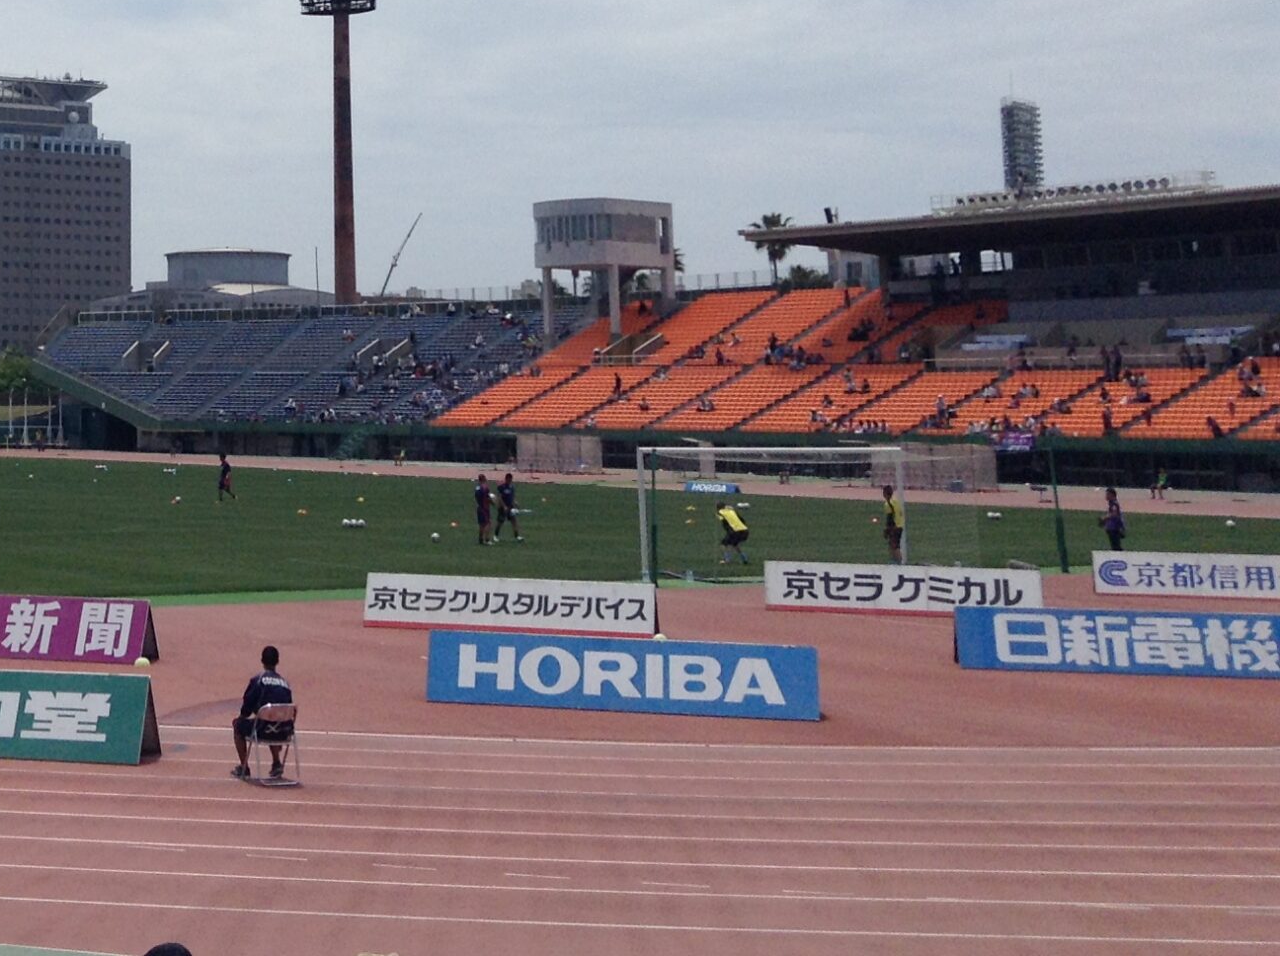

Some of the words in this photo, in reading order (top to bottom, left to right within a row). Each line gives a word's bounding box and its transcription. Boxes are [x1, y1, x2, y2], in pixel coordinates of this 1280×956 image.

[1131, 562, 1277, 592] 京都信用
[368, 586, 648, 622] 京セラクリスタルデバイス
[456, 644, 788, 707] HORIBA
